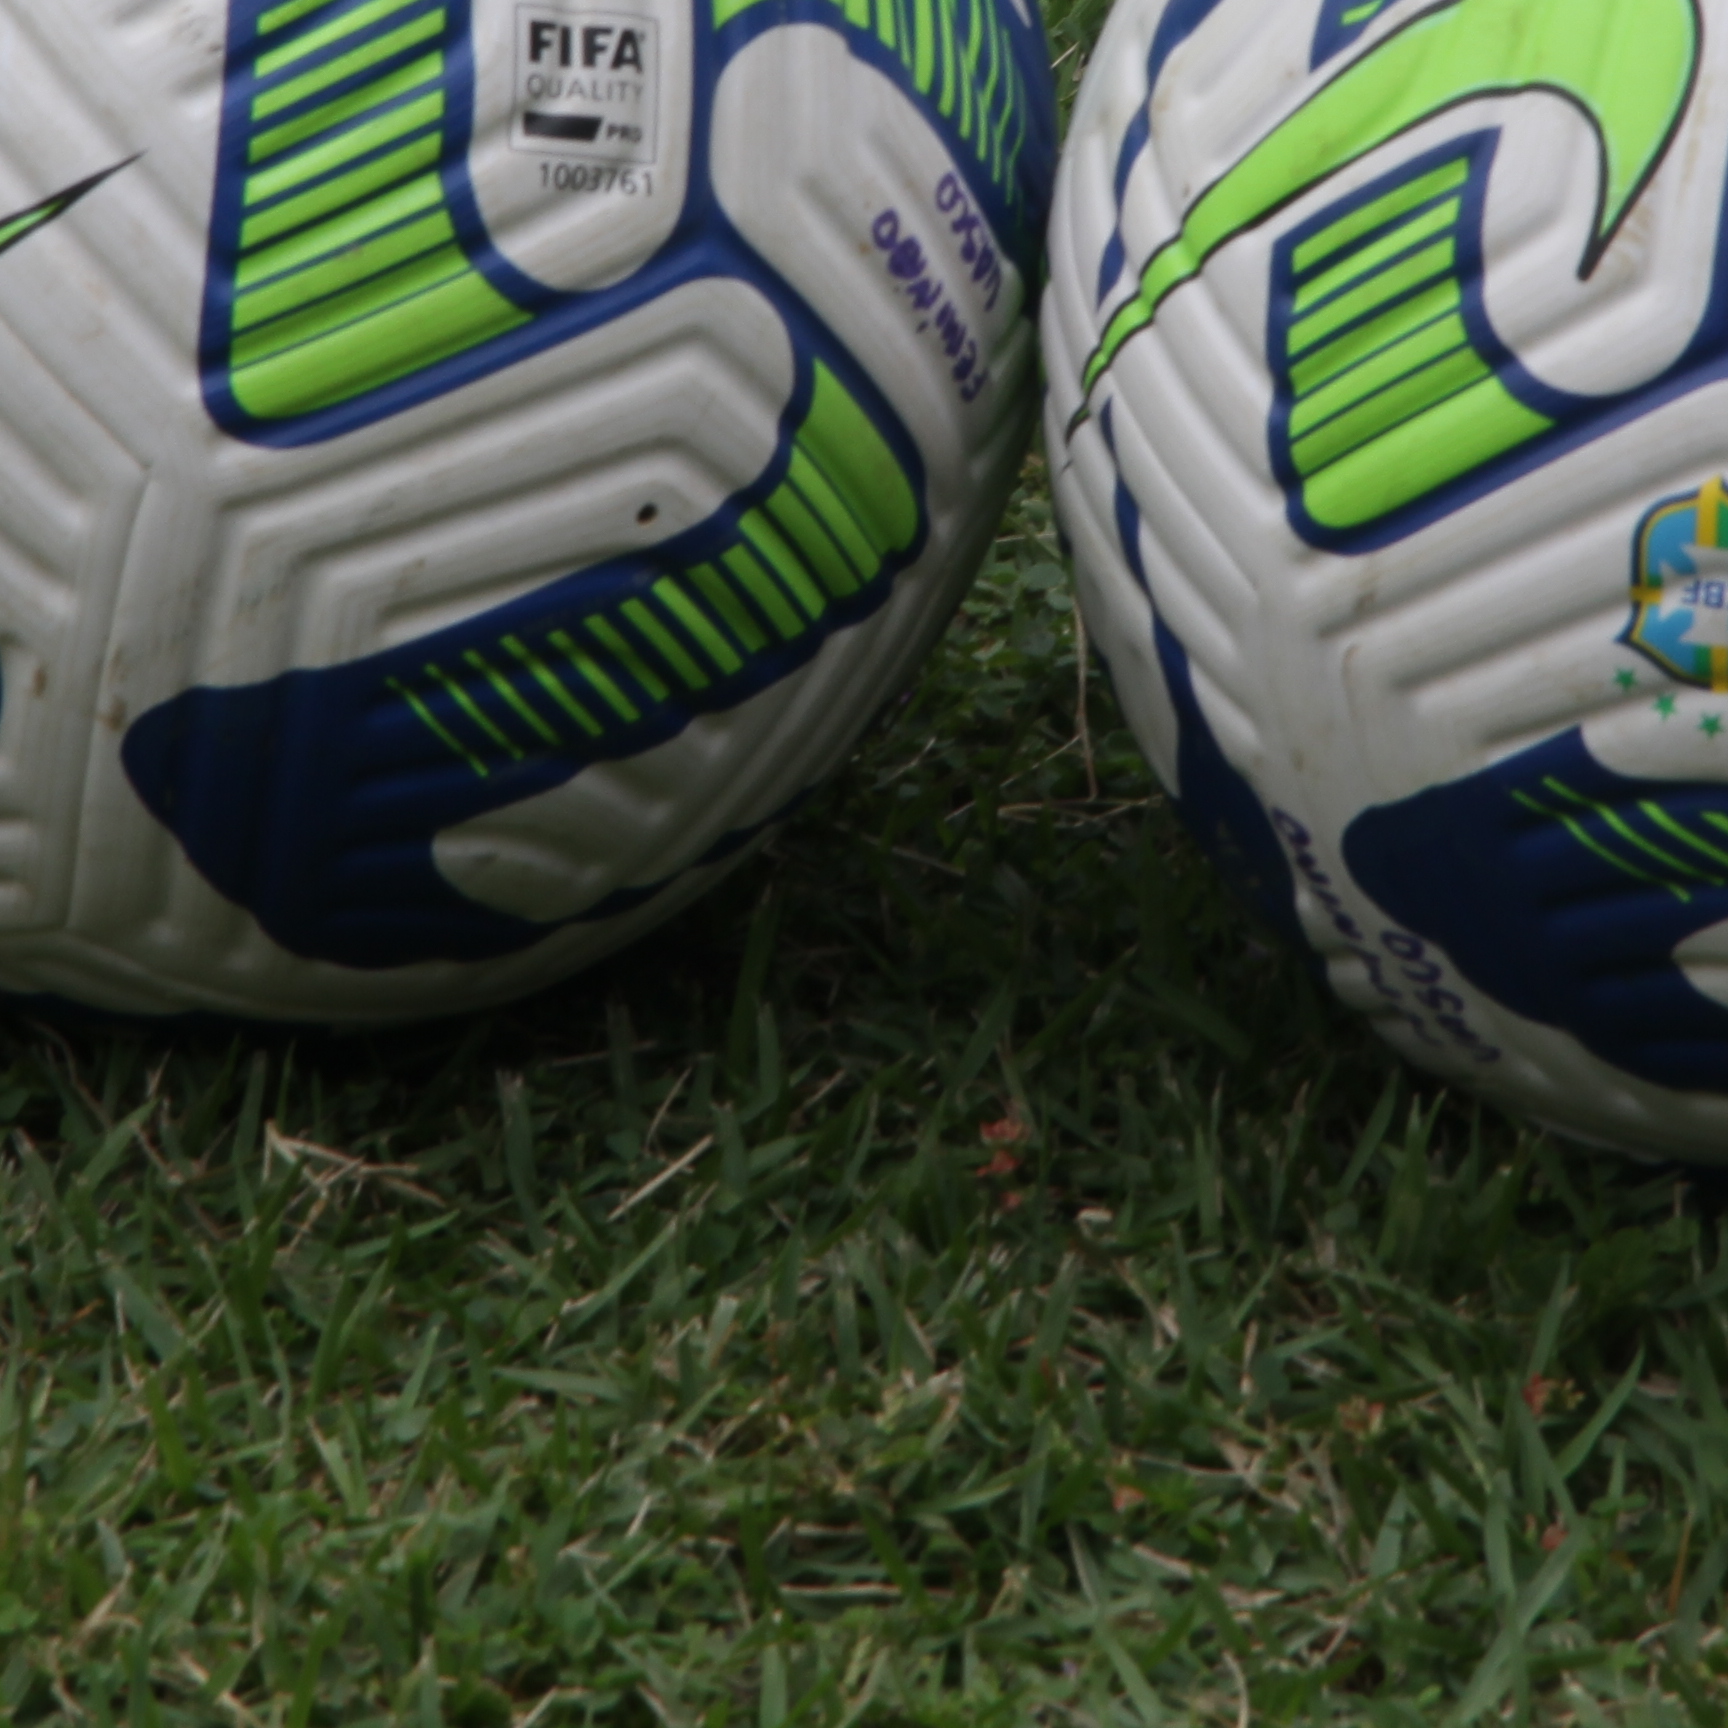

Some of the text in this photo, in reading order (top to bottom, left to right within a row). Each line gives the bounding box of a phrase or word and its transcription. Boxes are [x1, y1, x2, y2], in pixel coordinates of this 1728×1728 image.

[528, 19, 643, 74] FIFA
[527, 74, 644, 104] QUALITY
[606, 123, 643, 144] PRO
